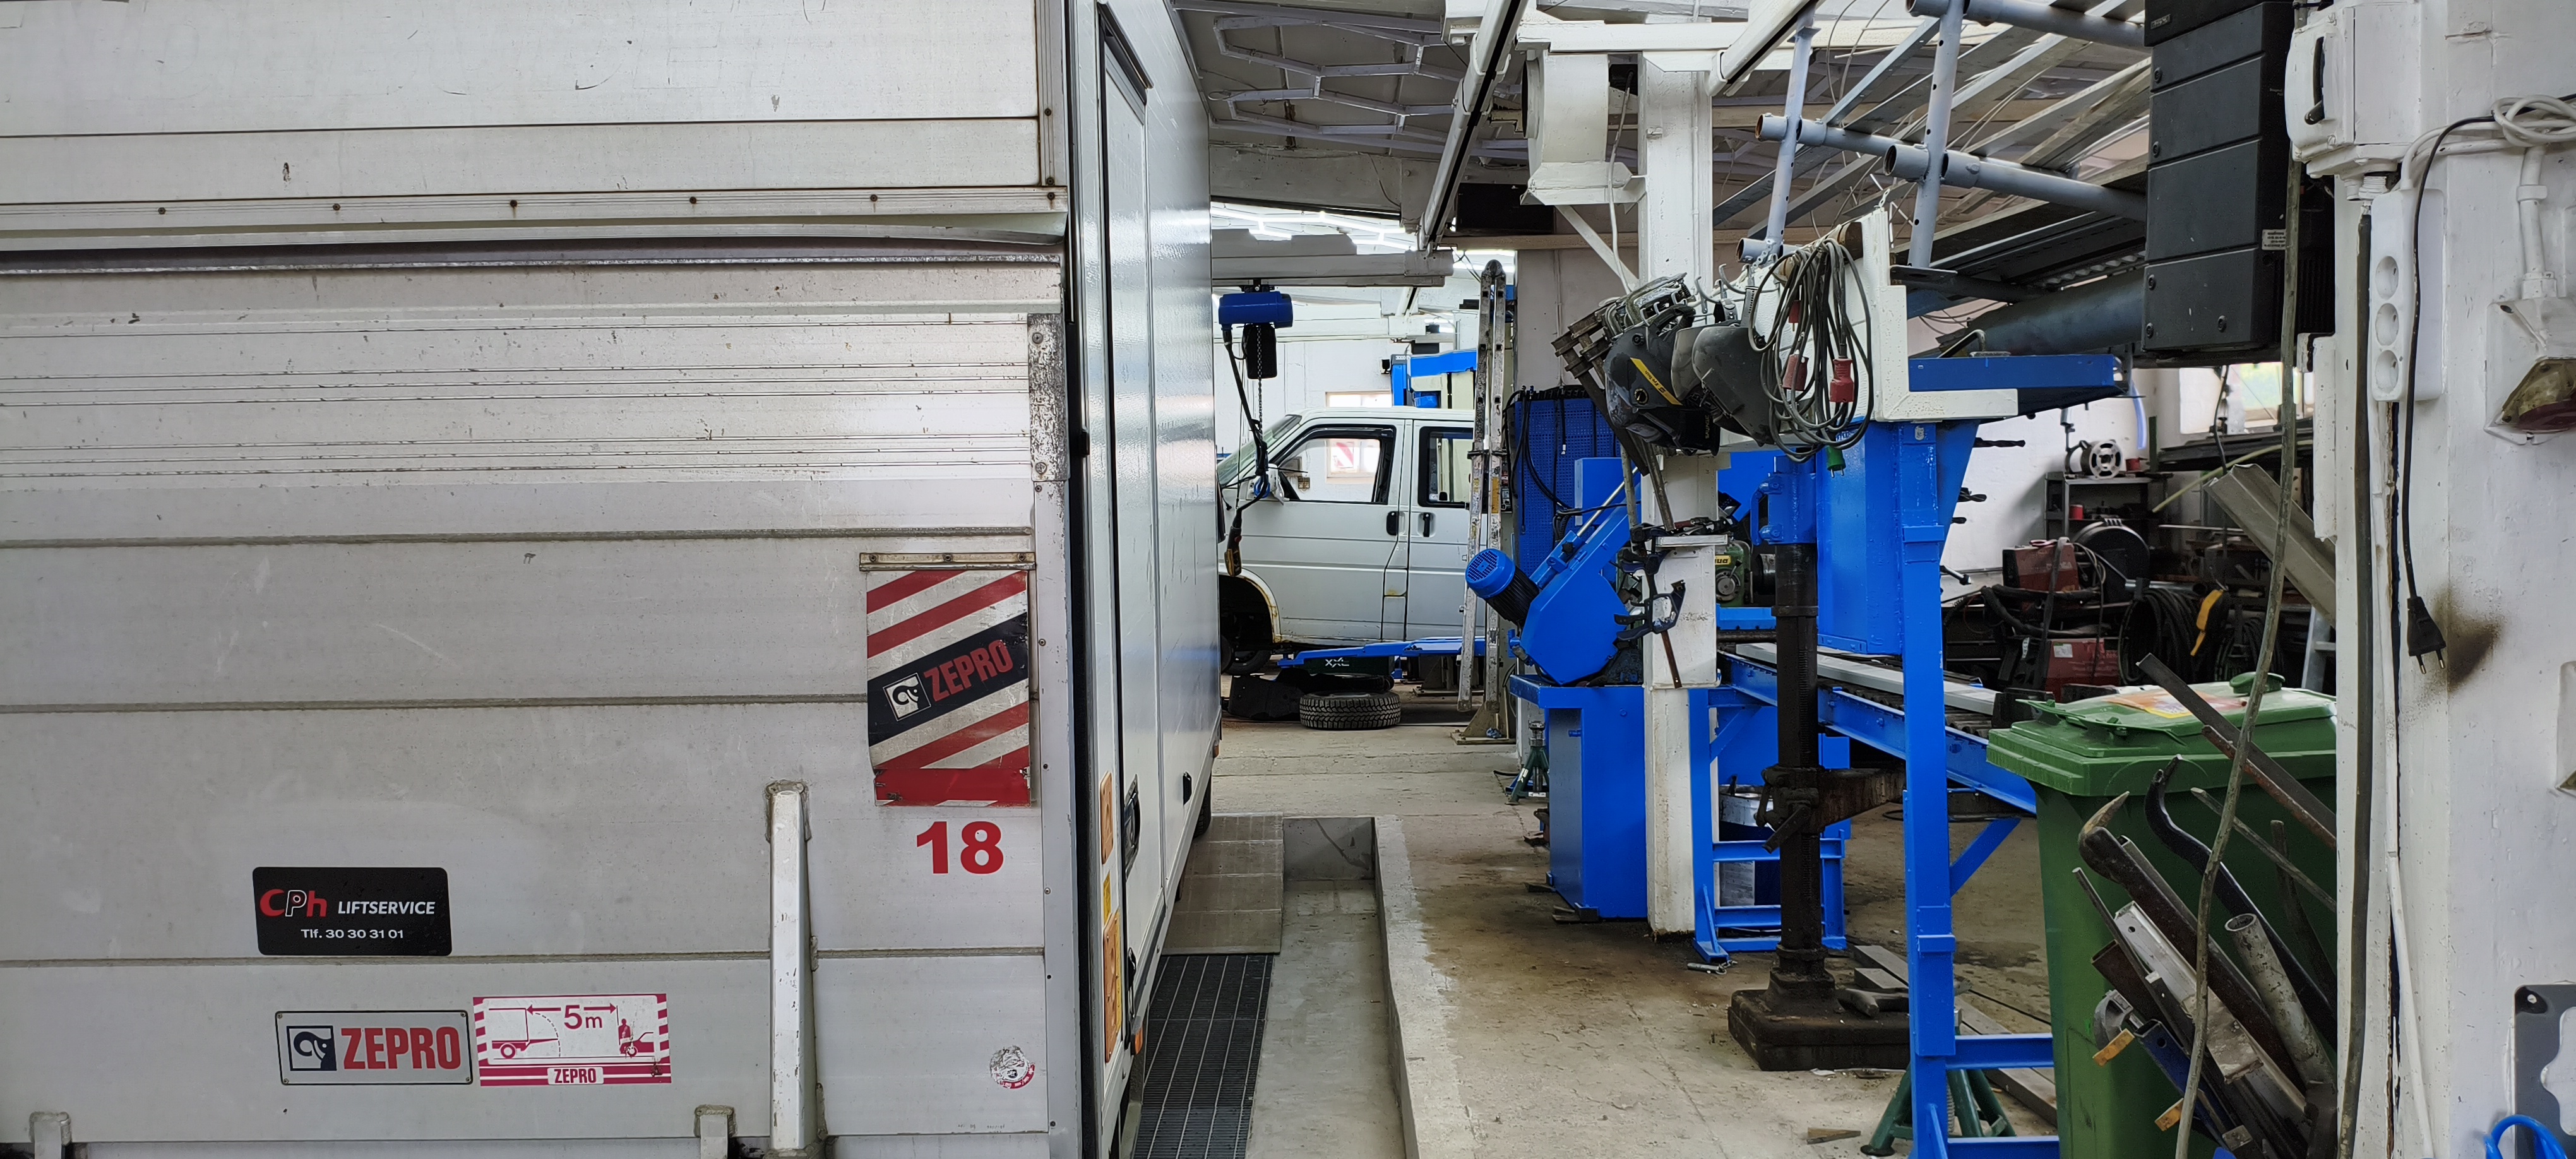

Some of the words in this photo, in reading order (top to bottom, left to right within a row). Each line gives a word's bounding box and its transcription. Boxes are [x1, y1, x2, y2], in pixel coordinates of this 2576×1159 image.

[923, 639, 1013, 702] ZEPRO
[917, 821, 1004, 874] 18
[259, 889, 328, 917] CPh
[338, 901, 436, 915] LIFTSERVICE
[301, 928, 323, 939] Tlf.
[325, 929, 345, 939] 30
[347, 929, 366, 939] 30
[369, 929, 385, 939] 31
[388, 929, 403, 939] 01
[564, 1004, 604, 1030] 5m
[341, 1026, 462, 1070] ZEPRO
[554, 1068, 597, 1084] ZEPRO
